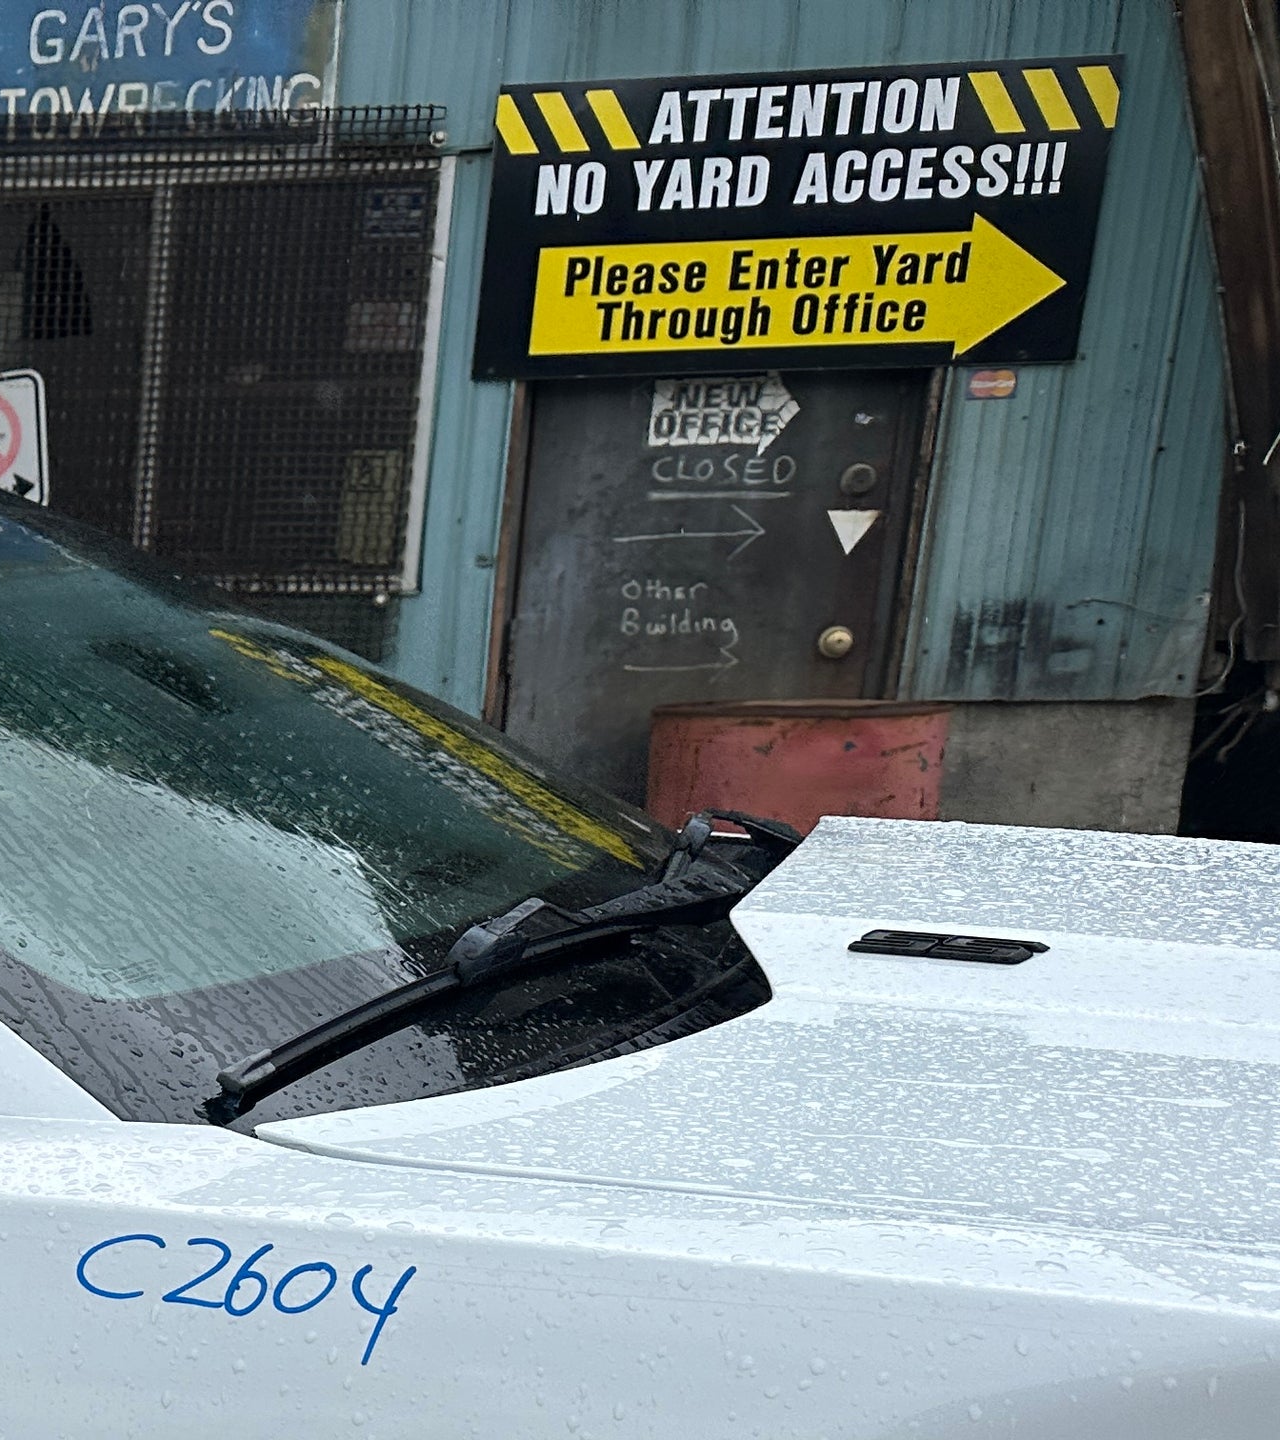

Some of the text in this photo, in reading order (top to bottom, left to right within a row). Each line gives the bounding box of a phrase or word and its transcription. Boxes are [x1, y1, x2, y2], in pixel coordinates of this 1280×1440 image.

[28, 0, 235, 65] GARY'S
[648, 76, 961, 145] ATTENTION
[534, 141, 1068, 216] NO YARD ACCESS!!!
[564, 241, 972, 297] Please Enter Yard
[595, 291, 928, 345] Through Office
[672, 382, 763, 410] NEW
[653, 408, 781, 440] OFFICE
[651, 453, 797, 485] CLOSED
[621, 579, 709, 601] Other
[620, 607, 740, 649] Building
[76, 1234, 417, 1366] C2604
